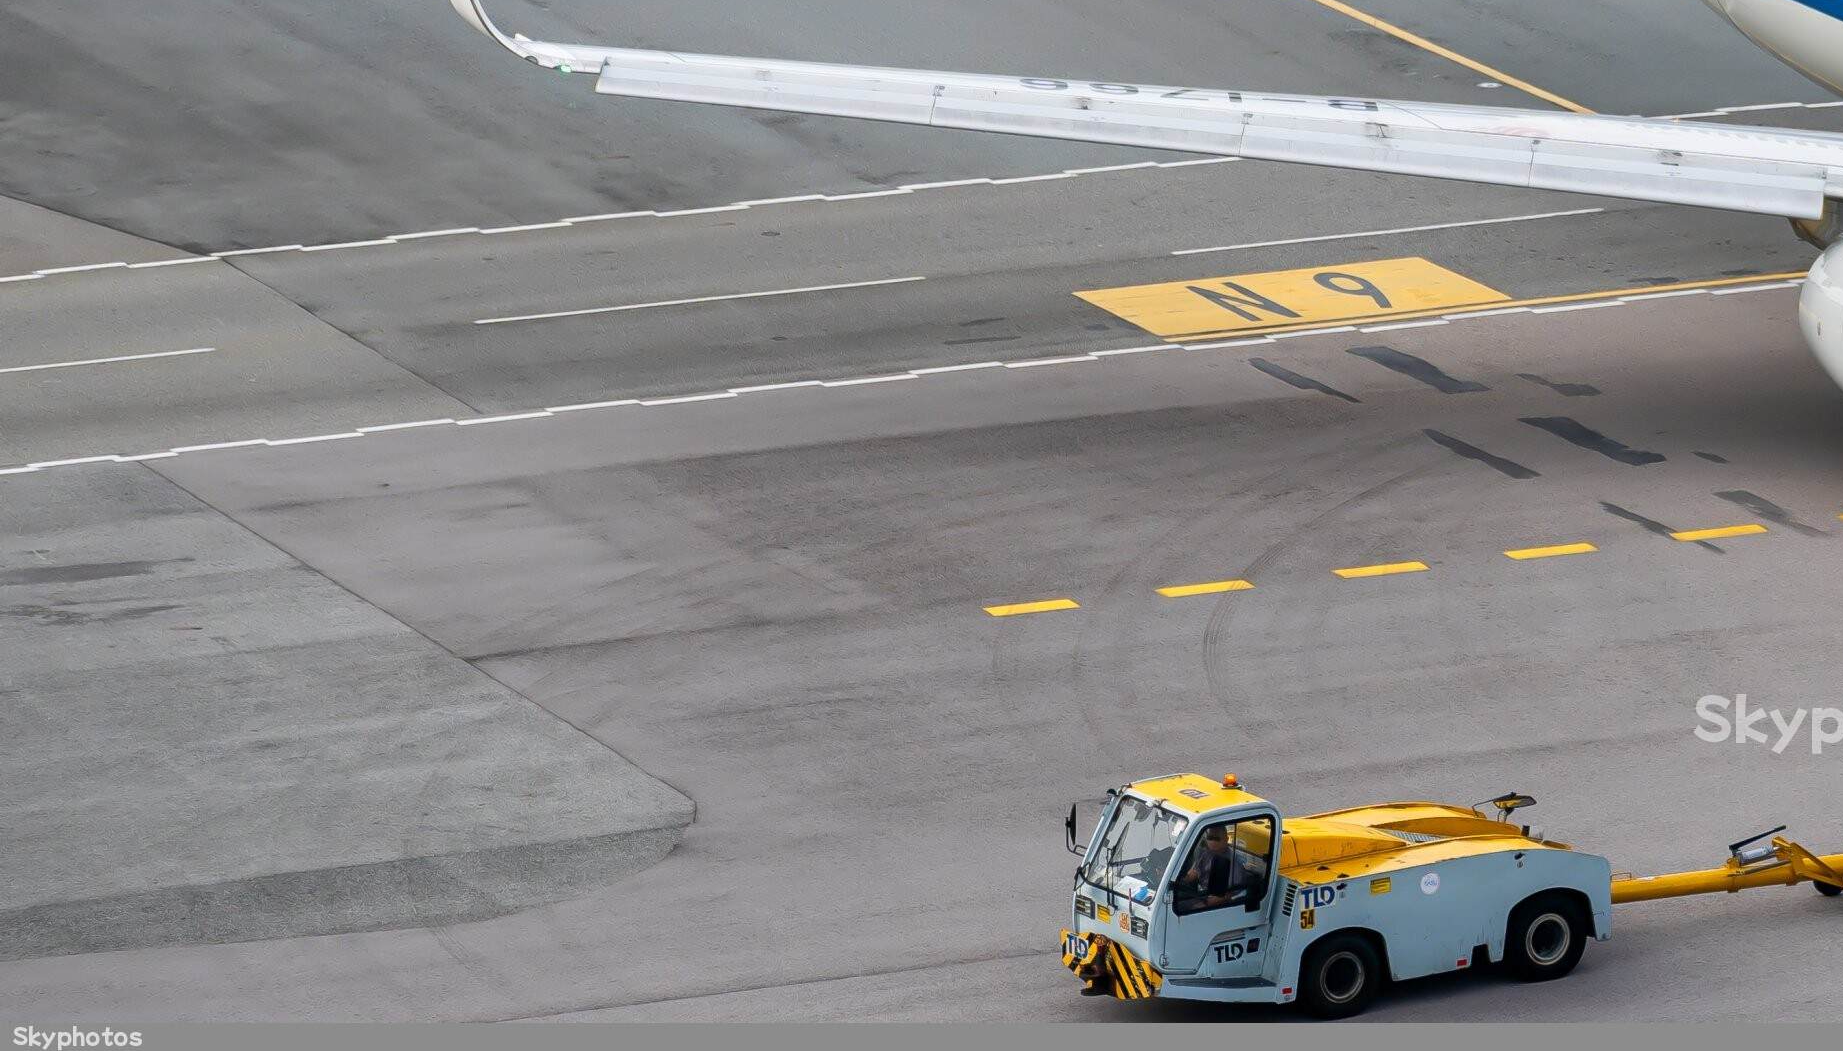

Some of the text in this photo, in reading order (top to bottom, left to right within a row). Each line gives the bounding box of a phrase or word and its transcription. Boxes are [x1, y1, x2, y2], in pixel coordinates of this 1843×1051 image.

[1300, 885, 1336, 910] TLD
[1300, 910, 1315, 930] 54
[1213, 942, 1245, 964] TLD
